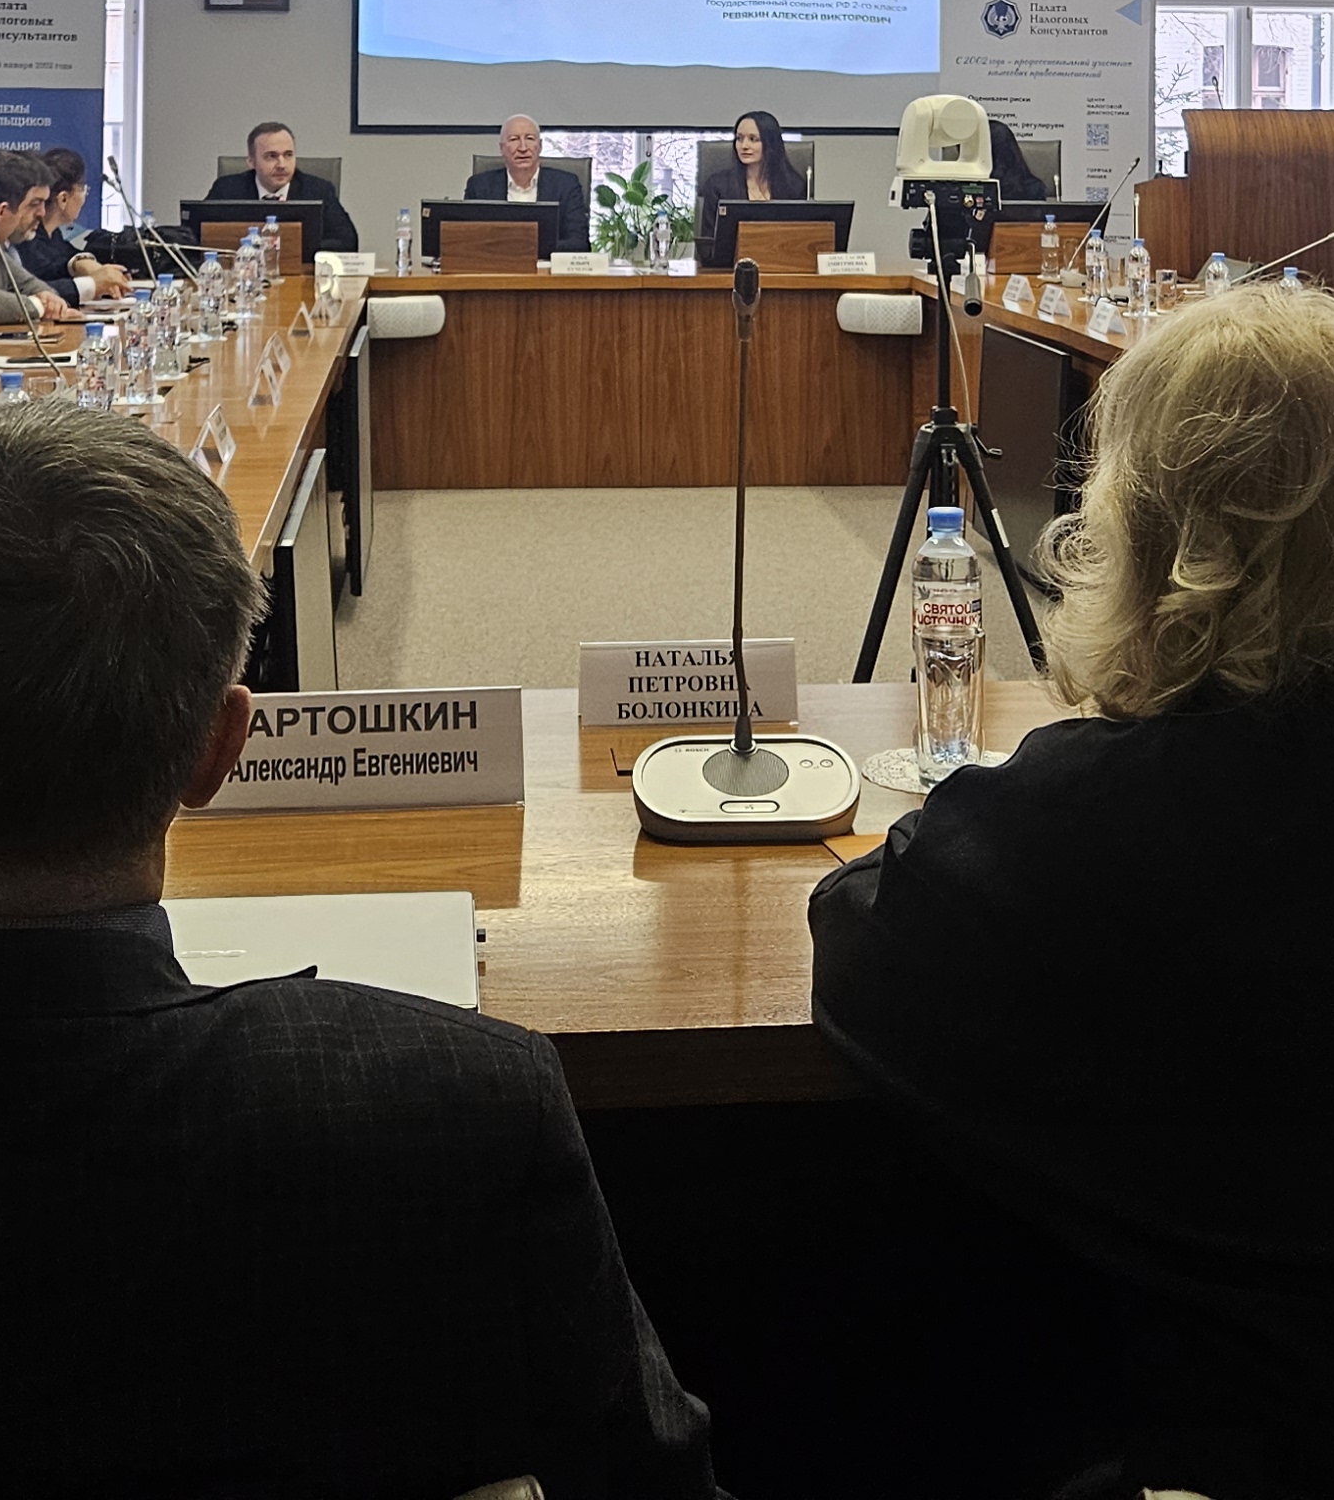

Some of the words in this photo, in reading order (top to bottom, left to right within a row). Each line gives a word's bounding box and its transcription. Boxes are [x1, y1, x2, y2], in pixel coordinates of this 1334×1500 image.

[789, 1, 834, 9] советник
[836, 1, 851, 10] РФ
[874, 2, 907, 12] класса
[1030, 2, 1067, 12] Палата
[722, 11, 769, 20] РЕВЯКИН
[771, 11, 818, 21] АЛЕКСЕЙ
[820, 13, 892, 24] ВИКТОРОВИЧ
[1030, 14, 1089, 24] Налоговых
[1030, 26, 1108, 37] Консультантов
[963, 56, 988, 66] 2002
[923, 602, 971, 615] СВЯТОЙ
[248, 700, 477, 738] АРТОШКИН
[228, 754, 347, 785] Александр
[353, 748, 478, 777] Евгениевич
